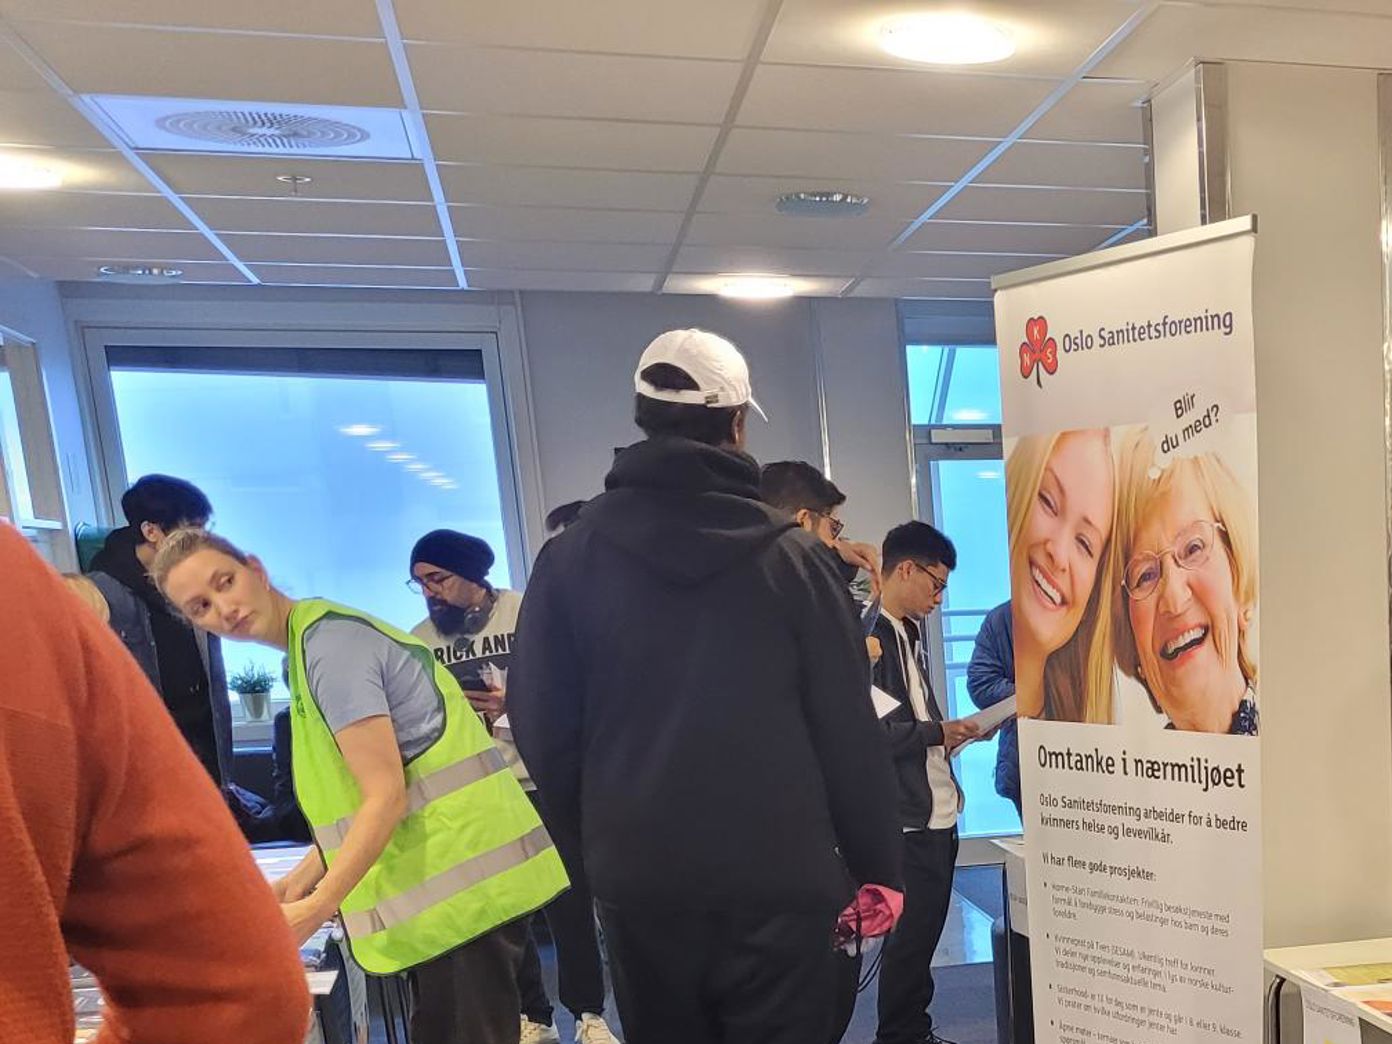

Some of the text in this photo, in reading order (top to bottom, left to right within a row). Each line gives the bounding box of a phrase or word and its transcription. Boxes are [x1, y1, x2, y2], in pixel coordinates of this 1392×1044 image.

[1062, 309, 1233, 353] Oslo Sanitetsforening
[1046, 348, 1053, 362] S
[1173, 392, 1196, 419] Blir
[1161, 404, 1219, 454] du med?
[1038, 745, 1245, 792] Omtanke i nærmiljøet
[1040, 793, 1247, 832] Oslo Sanitetsforening arbeider for å bedre
[1041, 812, 1173, 844] kvinners helse og levevilkår.
[1042, 852, 1156, 881] Vi har flere gode prosjekter:
